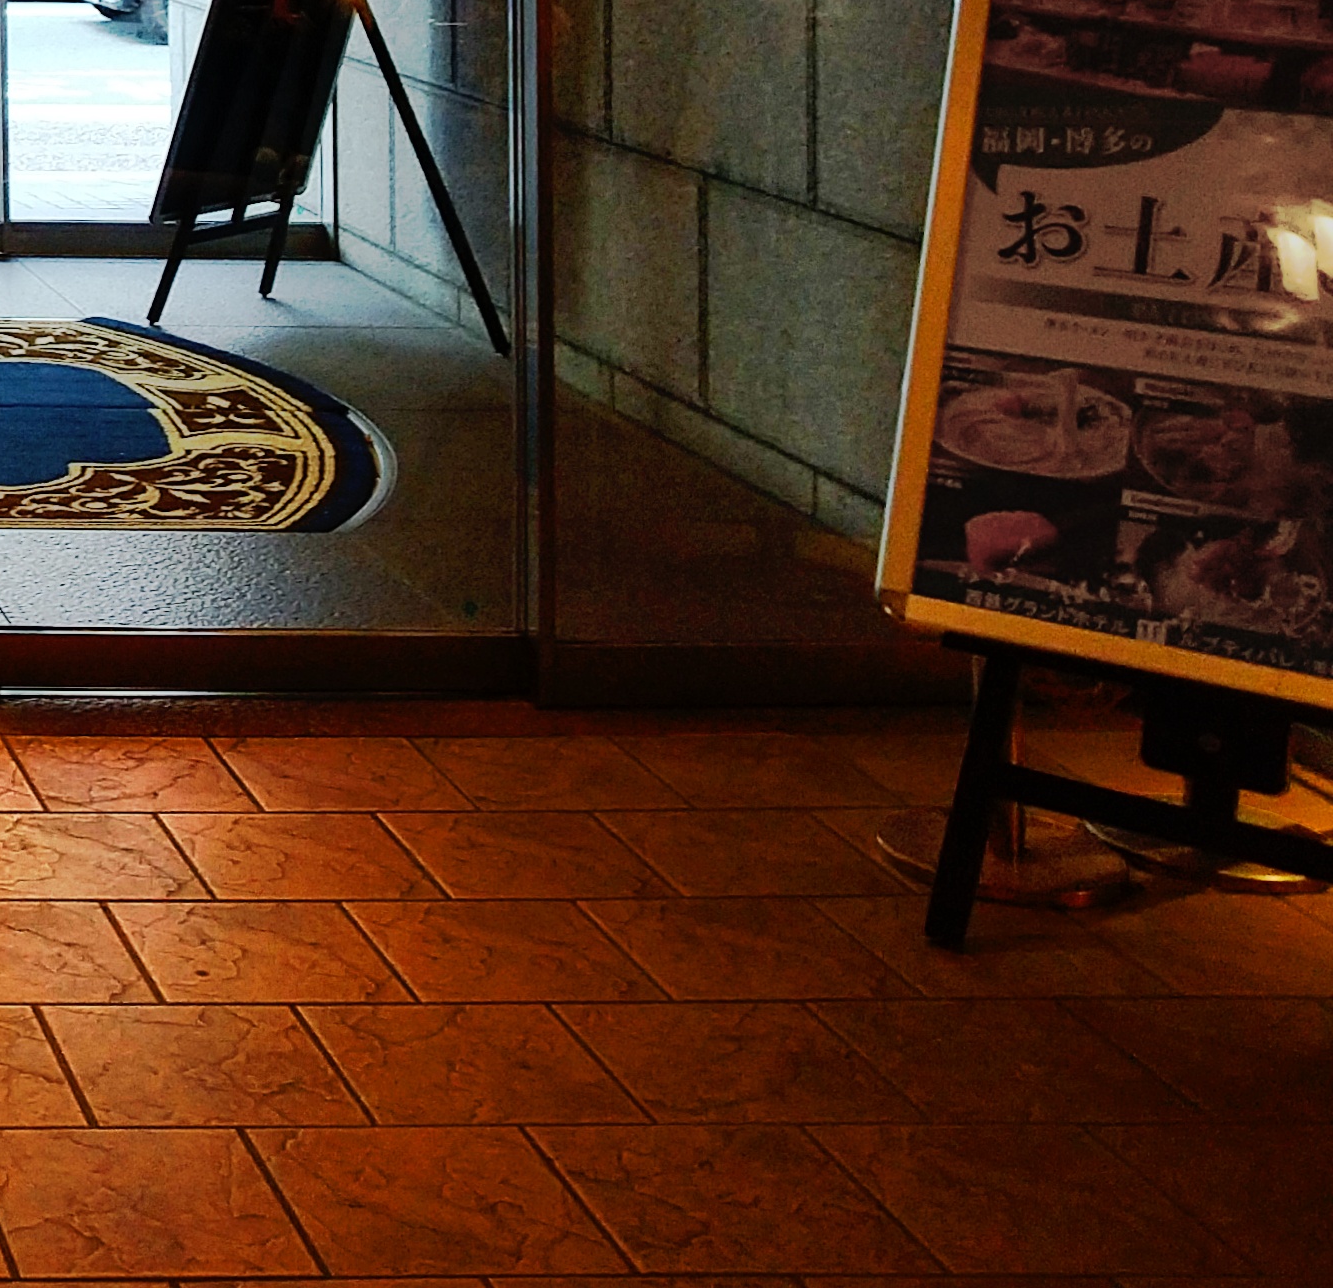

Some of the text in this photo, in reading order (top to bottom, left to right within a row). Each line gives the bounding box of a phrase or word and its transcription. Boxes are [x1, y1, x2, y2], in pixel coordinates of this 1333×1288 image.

[981, 125, 1155, 155] 福岡・博多の
